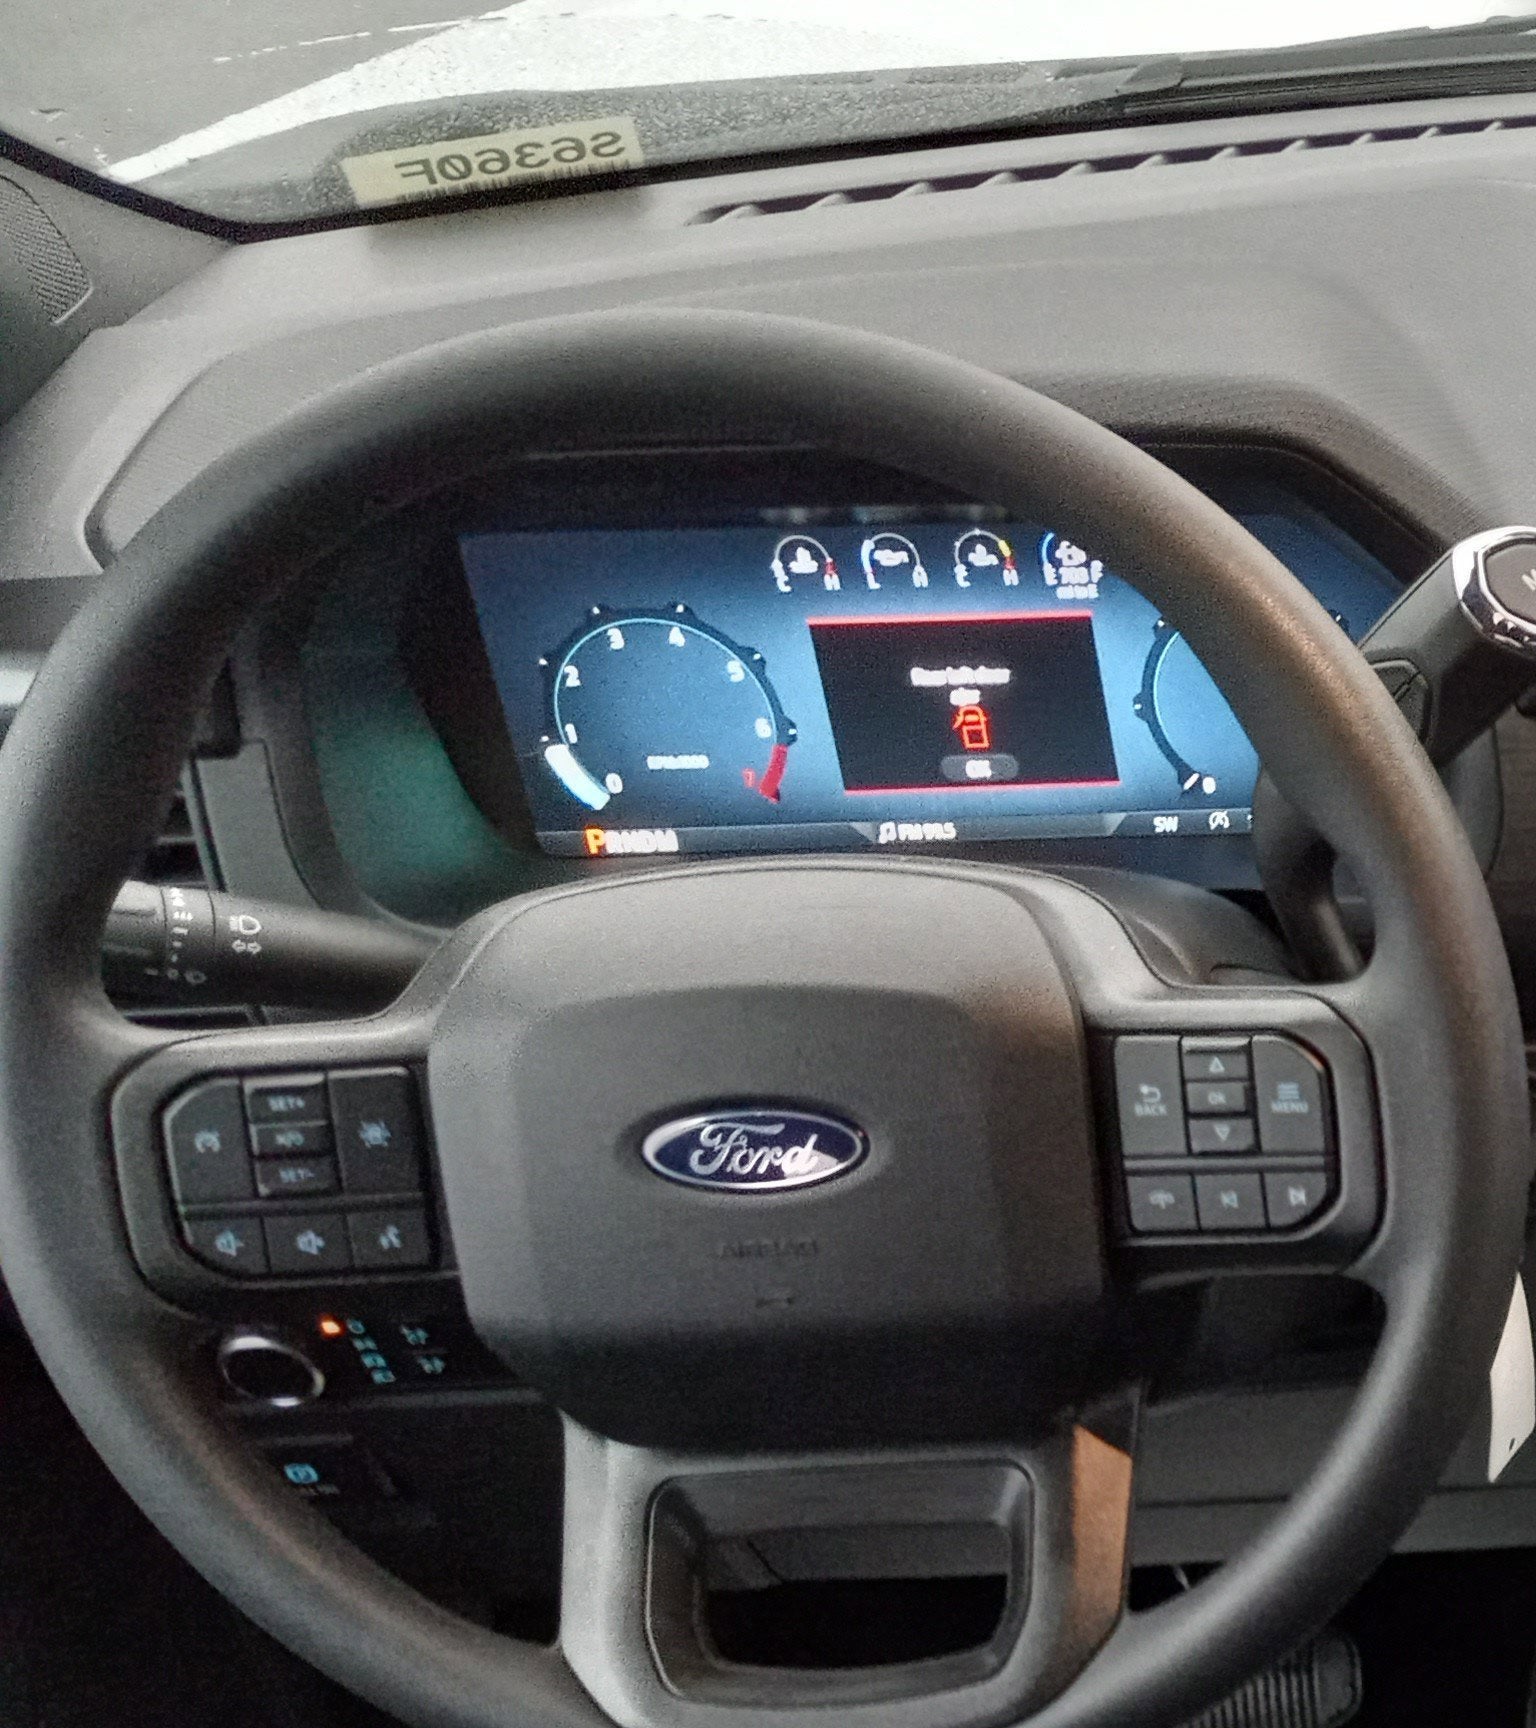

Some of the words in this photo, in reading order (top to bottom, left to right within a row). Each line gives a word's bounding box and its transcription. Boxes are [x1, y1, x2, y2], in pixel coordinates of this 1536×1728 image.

[607, 627, 625, 650] 3
[669, 626, 686, 648] 4
[564, 665, 581, 687] 2
[564, 723, 578, 744] 1
[605, 772, 624, 794] 0
[1134, 1103, 1168, 1118] BACK
[1270, 1102, 1310, 1115] MENU
[689, 1121, 819, 1176] Ford
